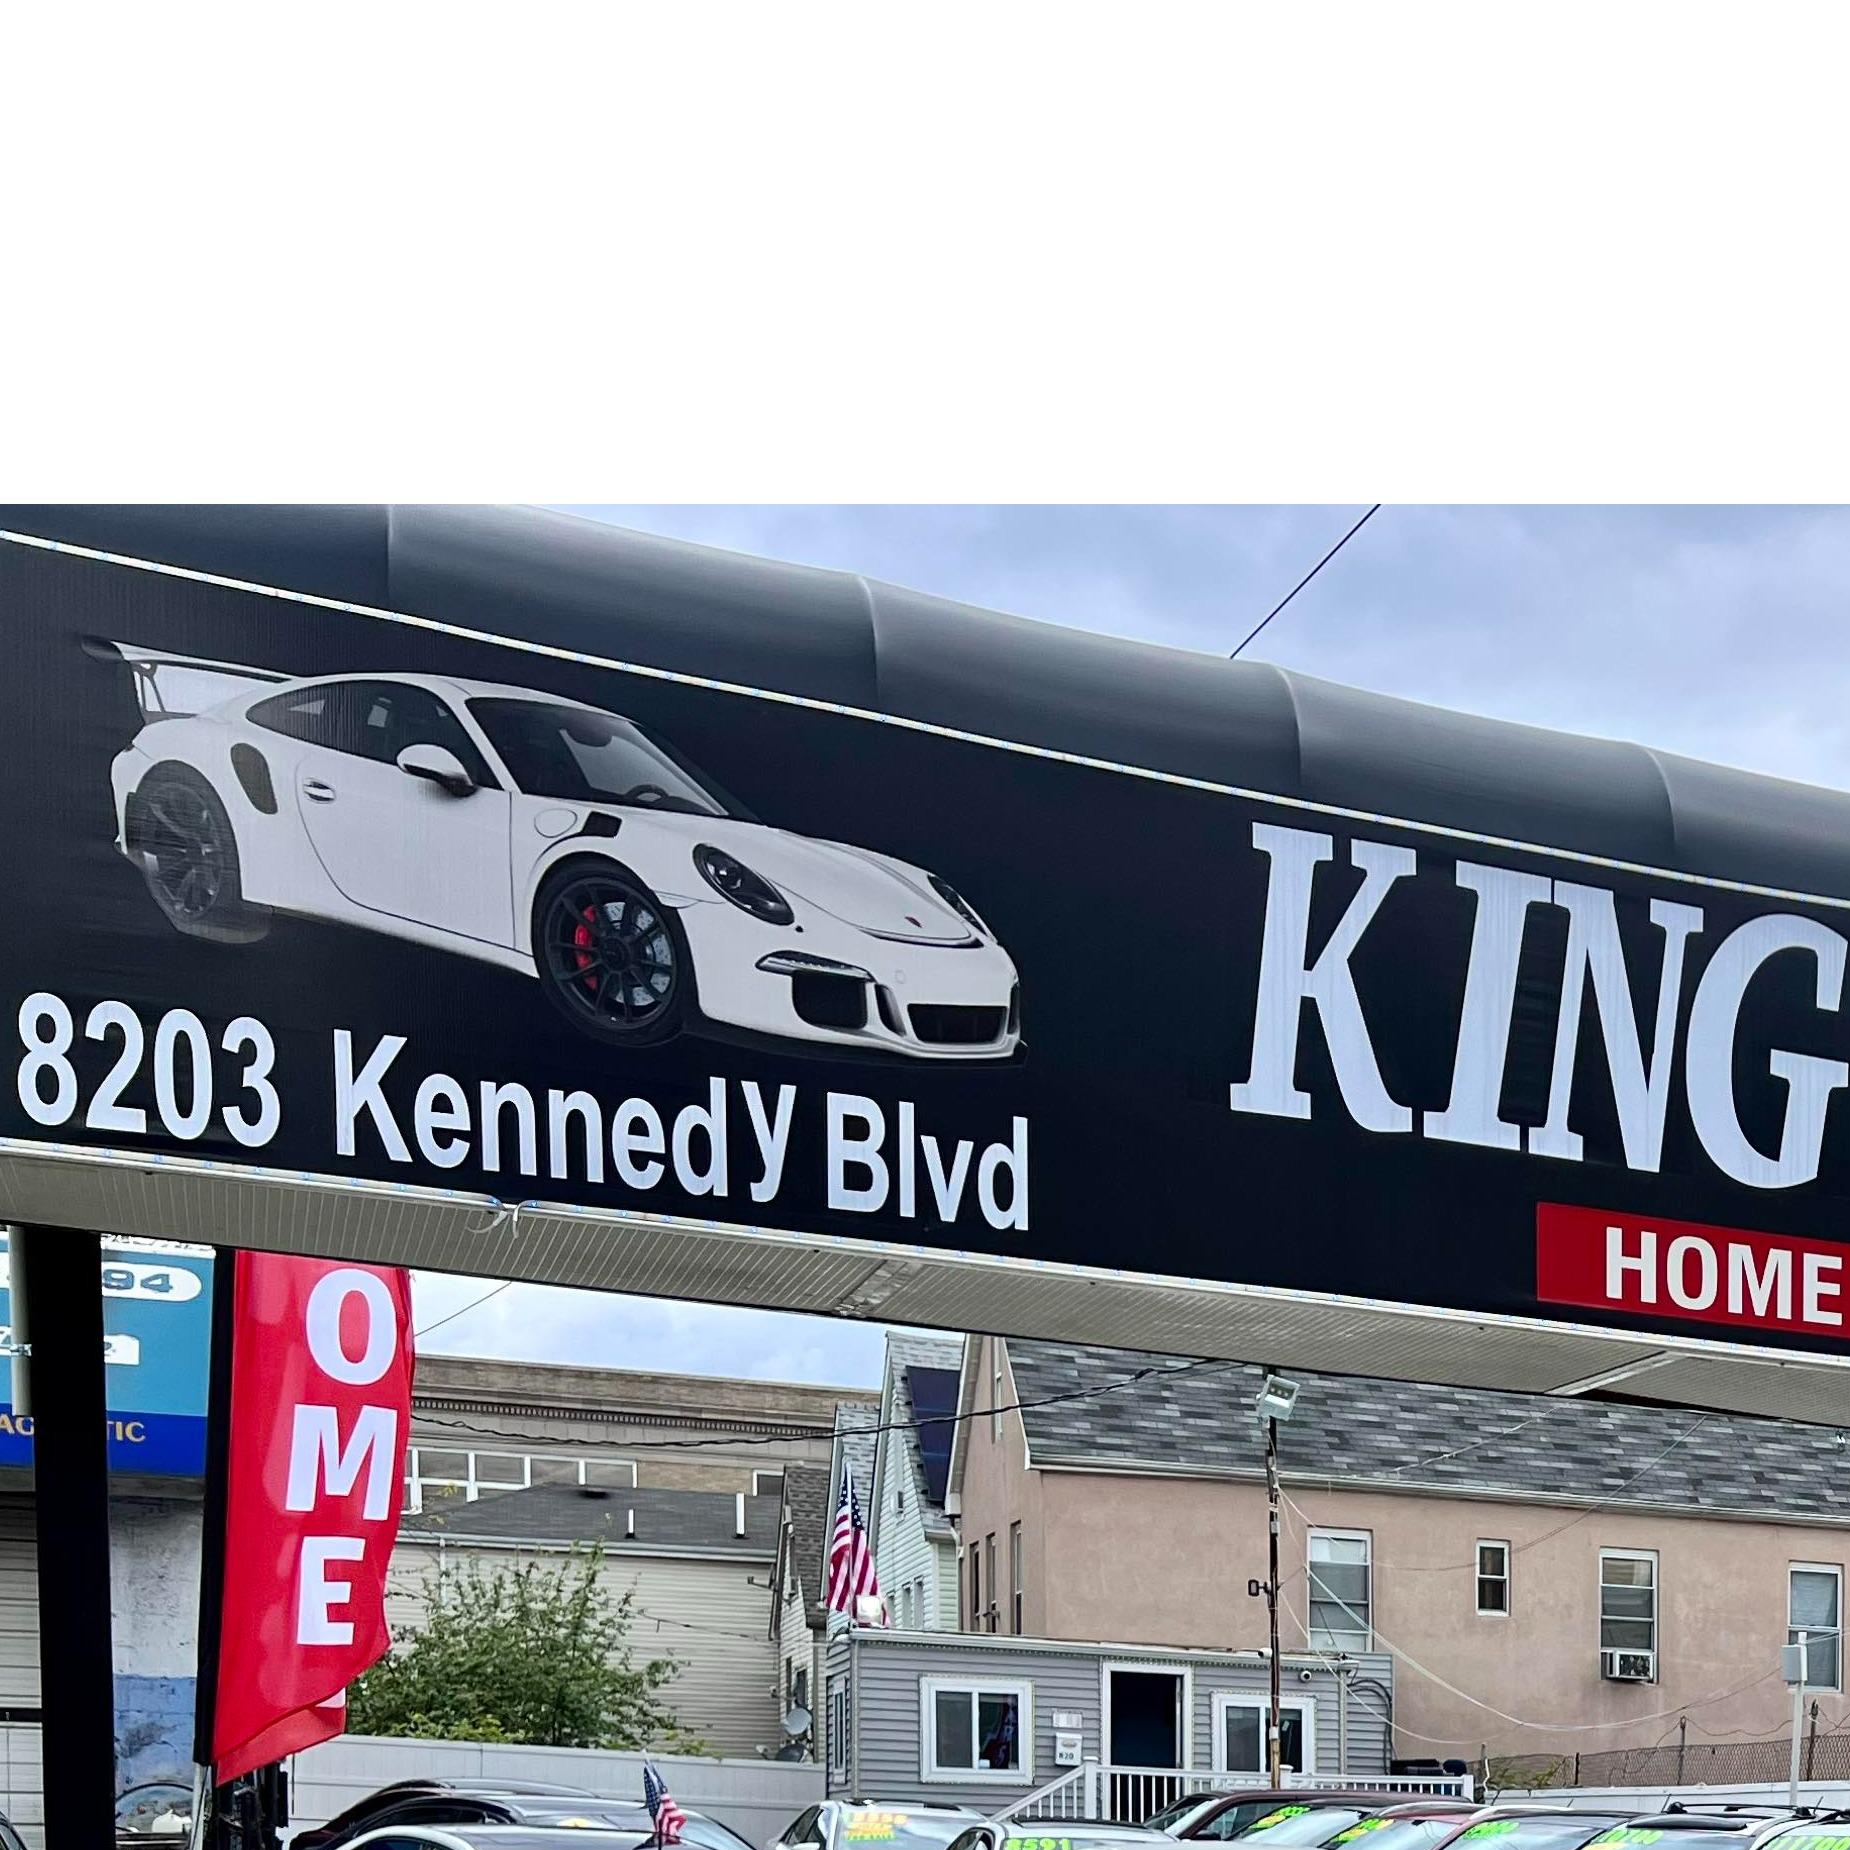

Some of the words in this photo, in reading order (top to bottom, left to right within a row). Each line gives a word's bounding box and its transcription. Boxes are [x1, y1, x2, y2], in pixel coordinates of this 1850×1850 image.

[17, 991, 281, 1148] 8203
[333, 1028, 797, 1203] Kennedy
[825, 1092, 1029, 1231] Blvd
[1230, 821, 1849, 1189] KING
[1606, 1226, 1843, 1326] HOME
